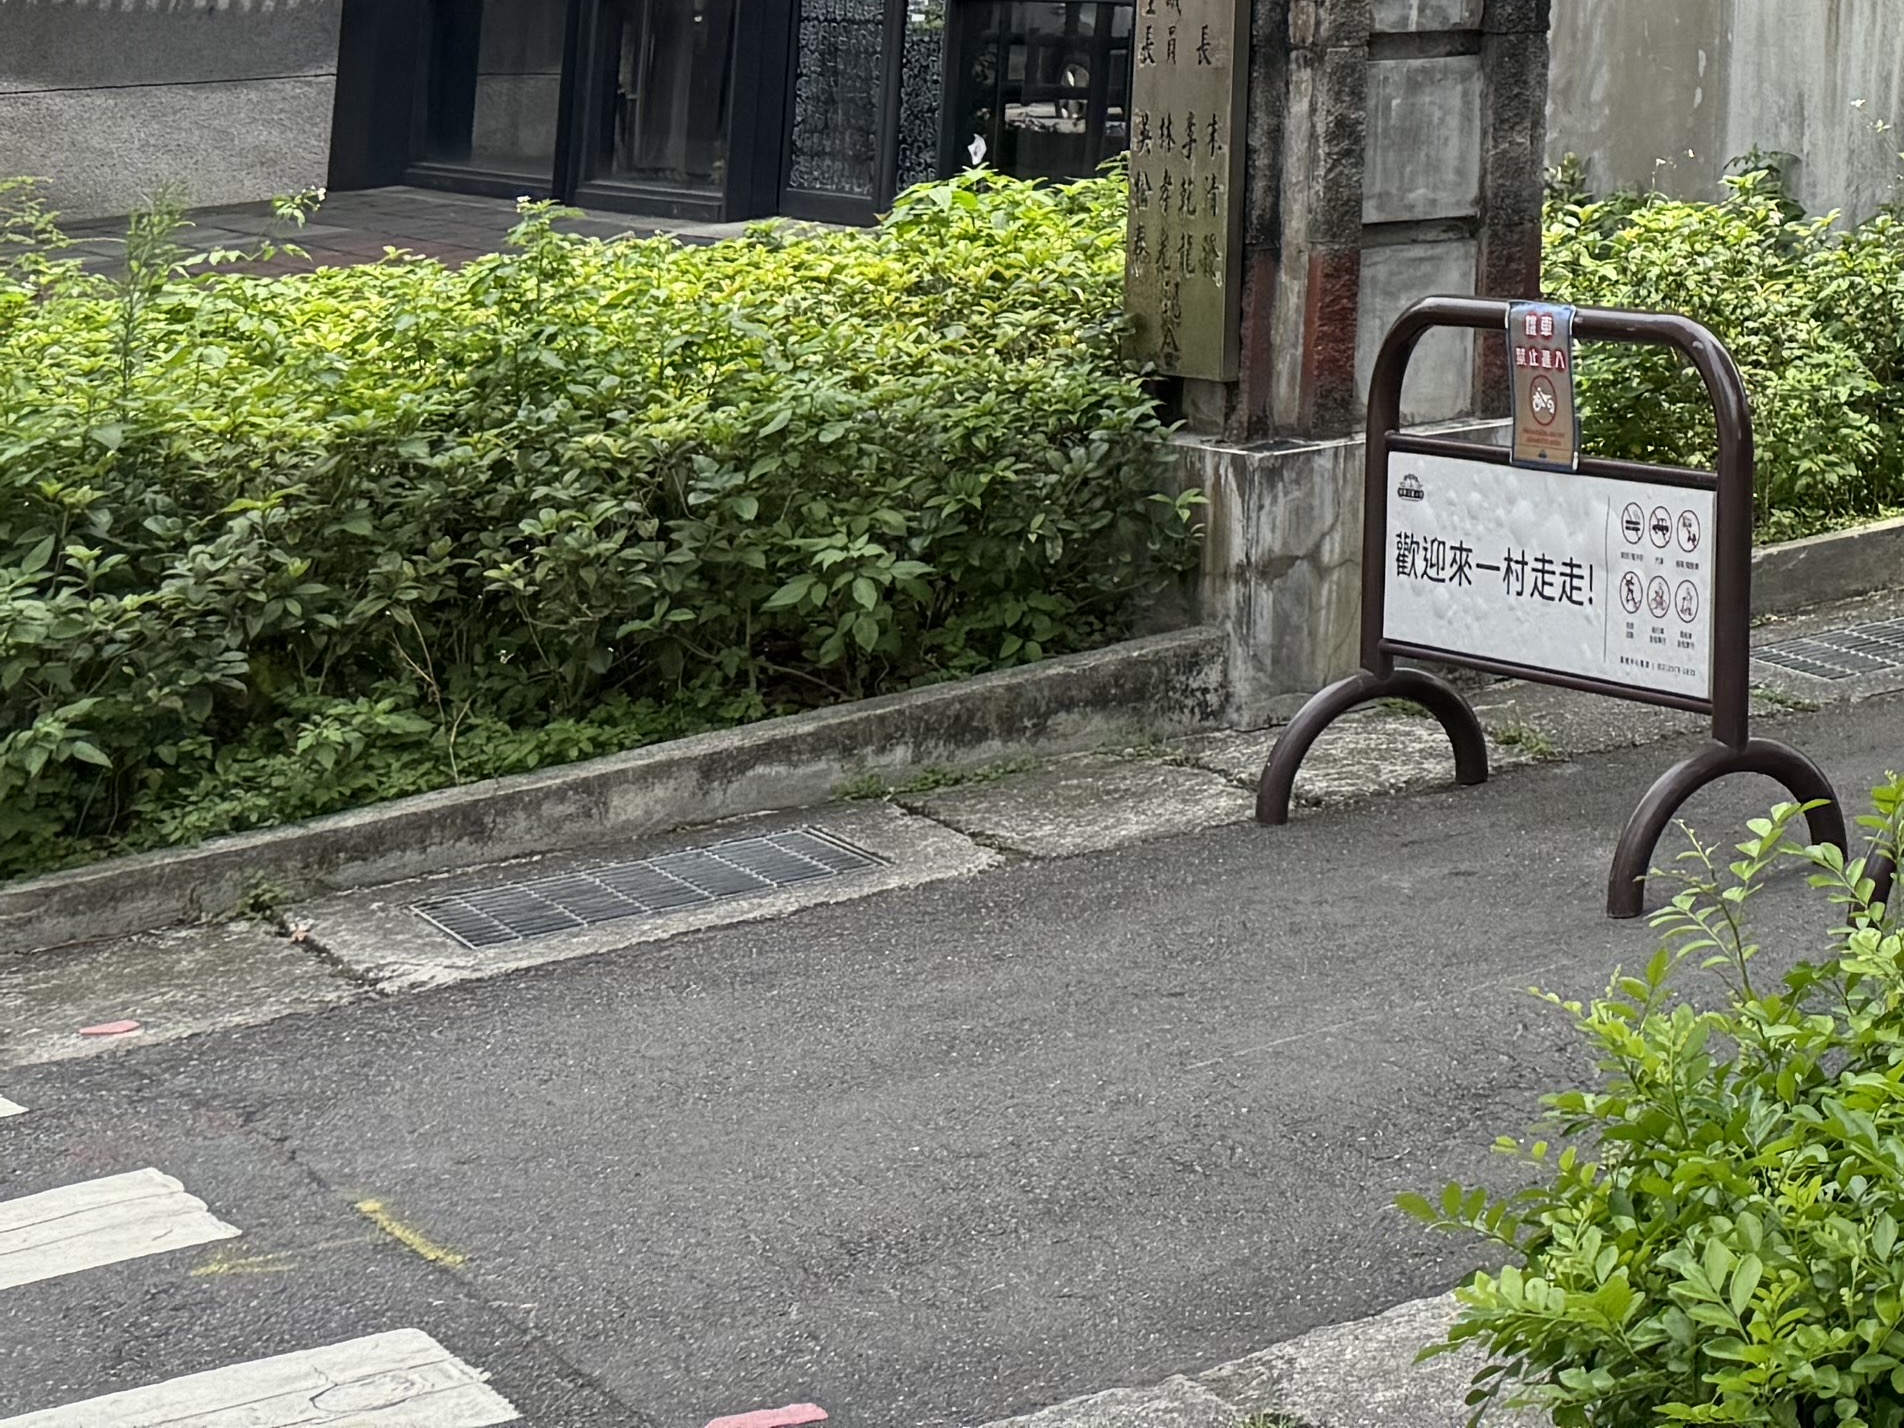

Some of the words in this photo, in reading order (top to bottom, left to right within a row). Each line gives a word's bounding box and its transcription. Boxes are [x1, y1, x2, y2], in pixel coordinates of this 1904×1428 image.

[1515, 347, 1565, 370] 禁止進入
[1396, 531, 1593, 606] 歡迎來一村走走!
